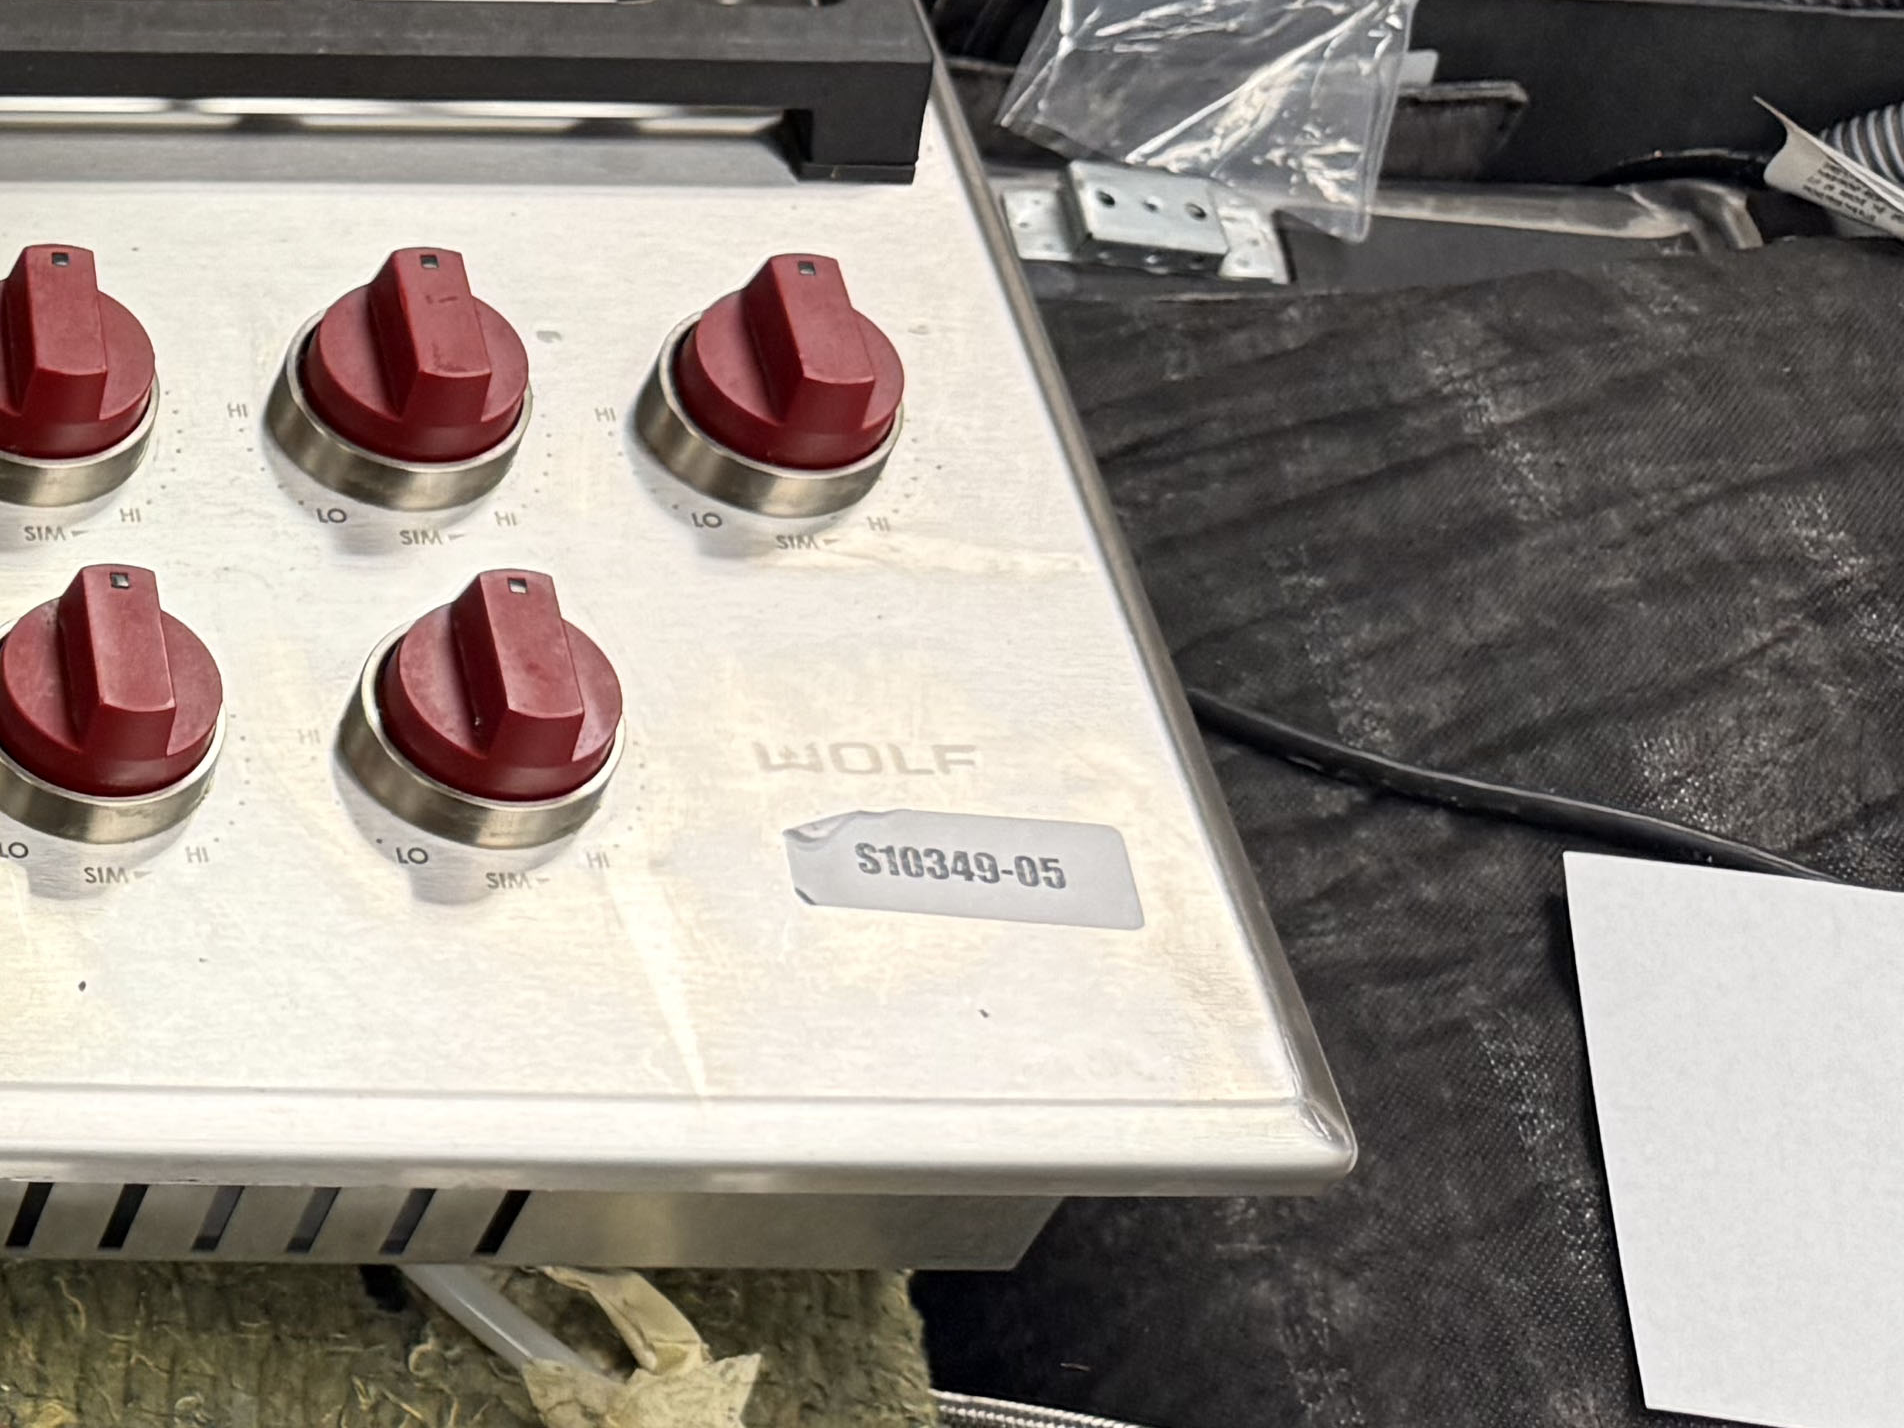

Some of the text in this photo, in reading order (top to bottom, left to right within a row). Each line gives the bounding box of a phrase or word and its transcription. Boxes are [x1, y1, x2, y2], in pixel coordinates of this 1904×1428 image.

[226, 403, 248, 418] HI
[594, 407, 616, 423] HI
[119, 508, 141, 522] HI
[316, 507, 348, 523] LO
[494, 510, 517, 527] HI
[692, 512, 723, 528] LO
[866, 515, 891, 532] HI
[24, 525, 67, 541] SIM
[399, 529, 443, 546] SIM
[775, 534, 819, 550] SIM
[297, 728, 321, 745] HI
[752, 741, 977, 775] WOLF
[185, 846, 210, 864] HI
[395, 846, 429, 864] LO
[586, 851, 610, 869] HI
[854, 841, 1068, 890] S10349-05
[83, 866, 130, 884] SIM
[485, 872, 532, 890] SIM
